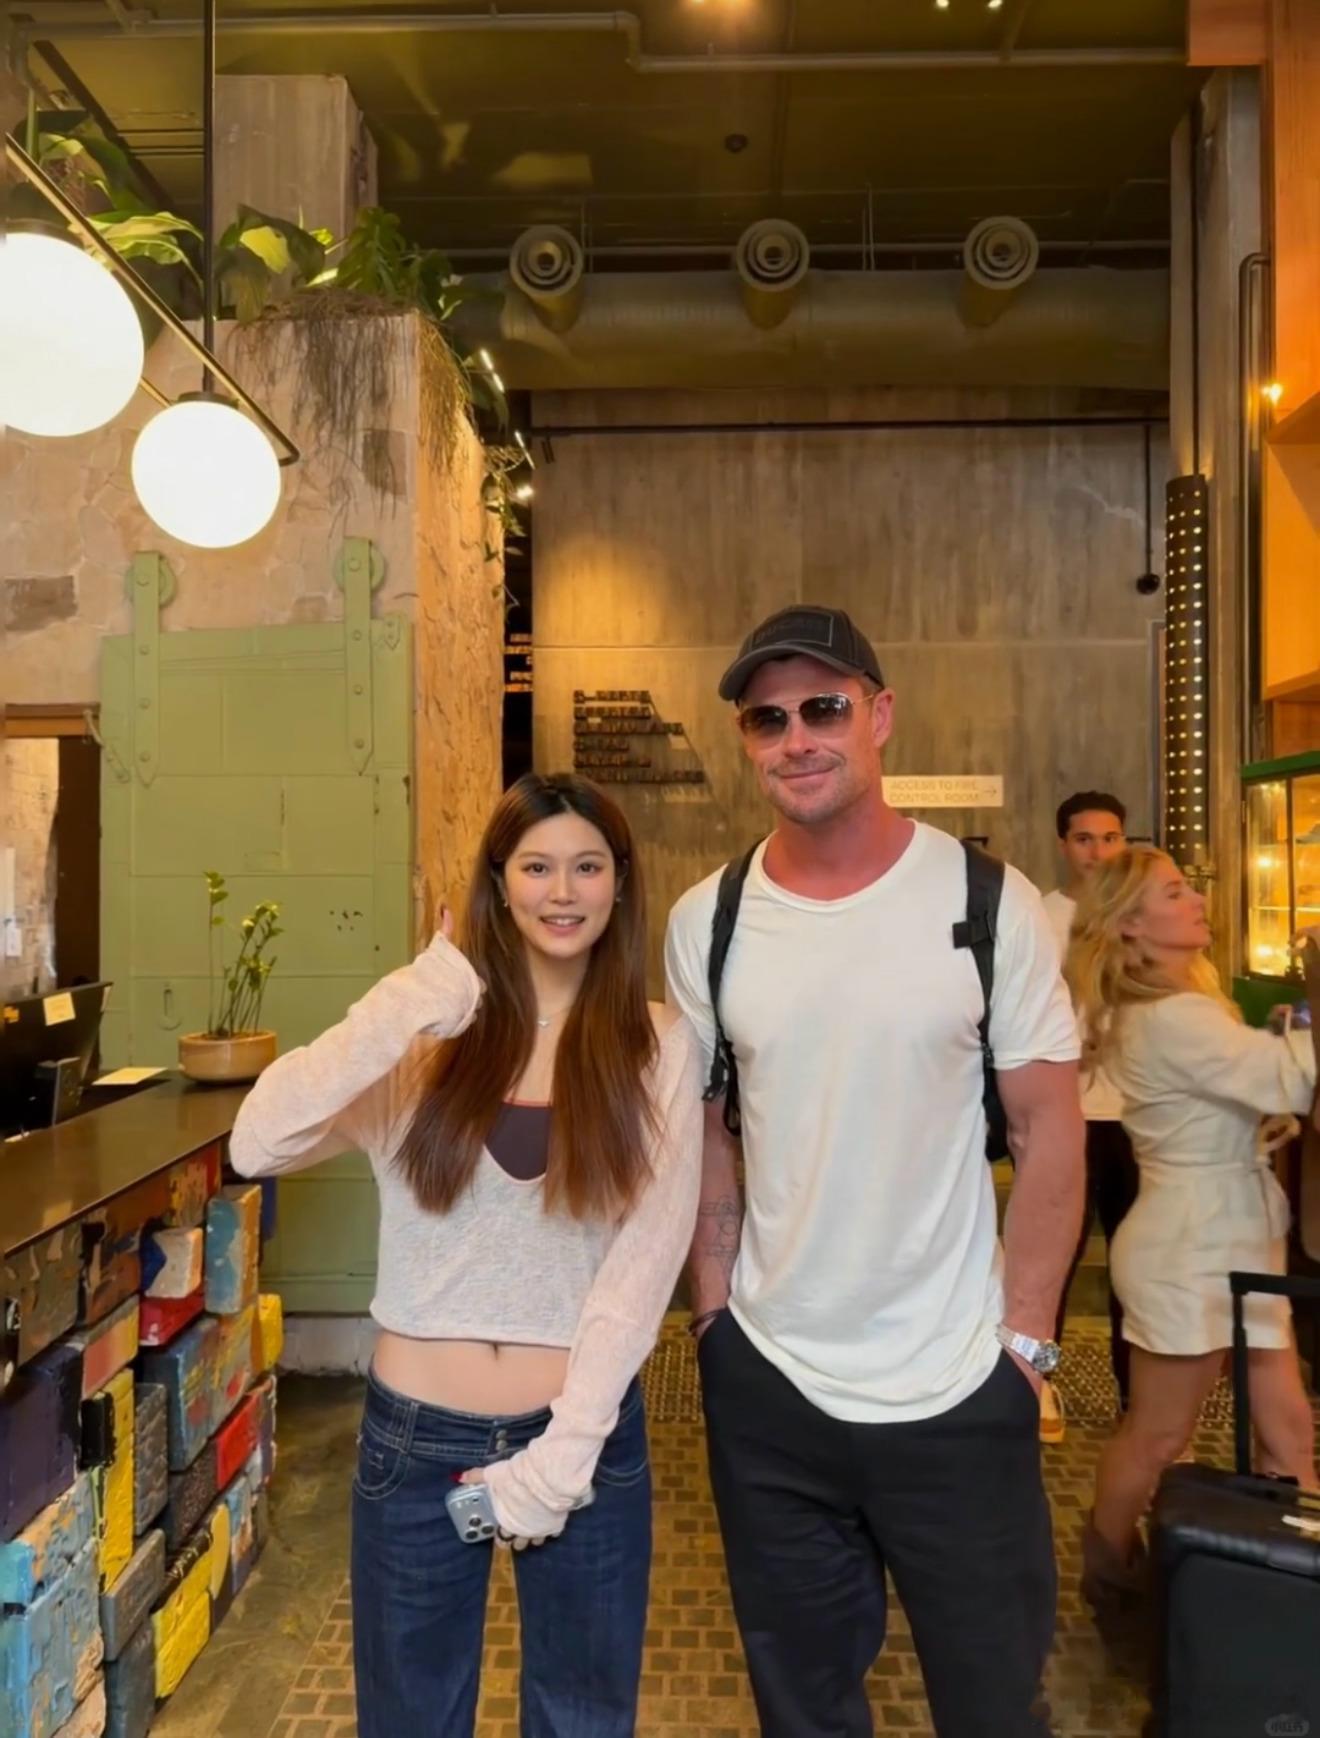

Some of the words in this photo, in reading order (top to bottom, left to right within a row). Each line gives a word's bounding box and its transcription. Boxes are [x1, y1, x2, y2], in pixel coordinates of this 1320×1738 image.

[890, 780, 936, 790] ACCESS
[939, 780, 952, 790] TO
[890, 792, 940, 802] CONTROL
[944, 792, 979, 802] ROOM
